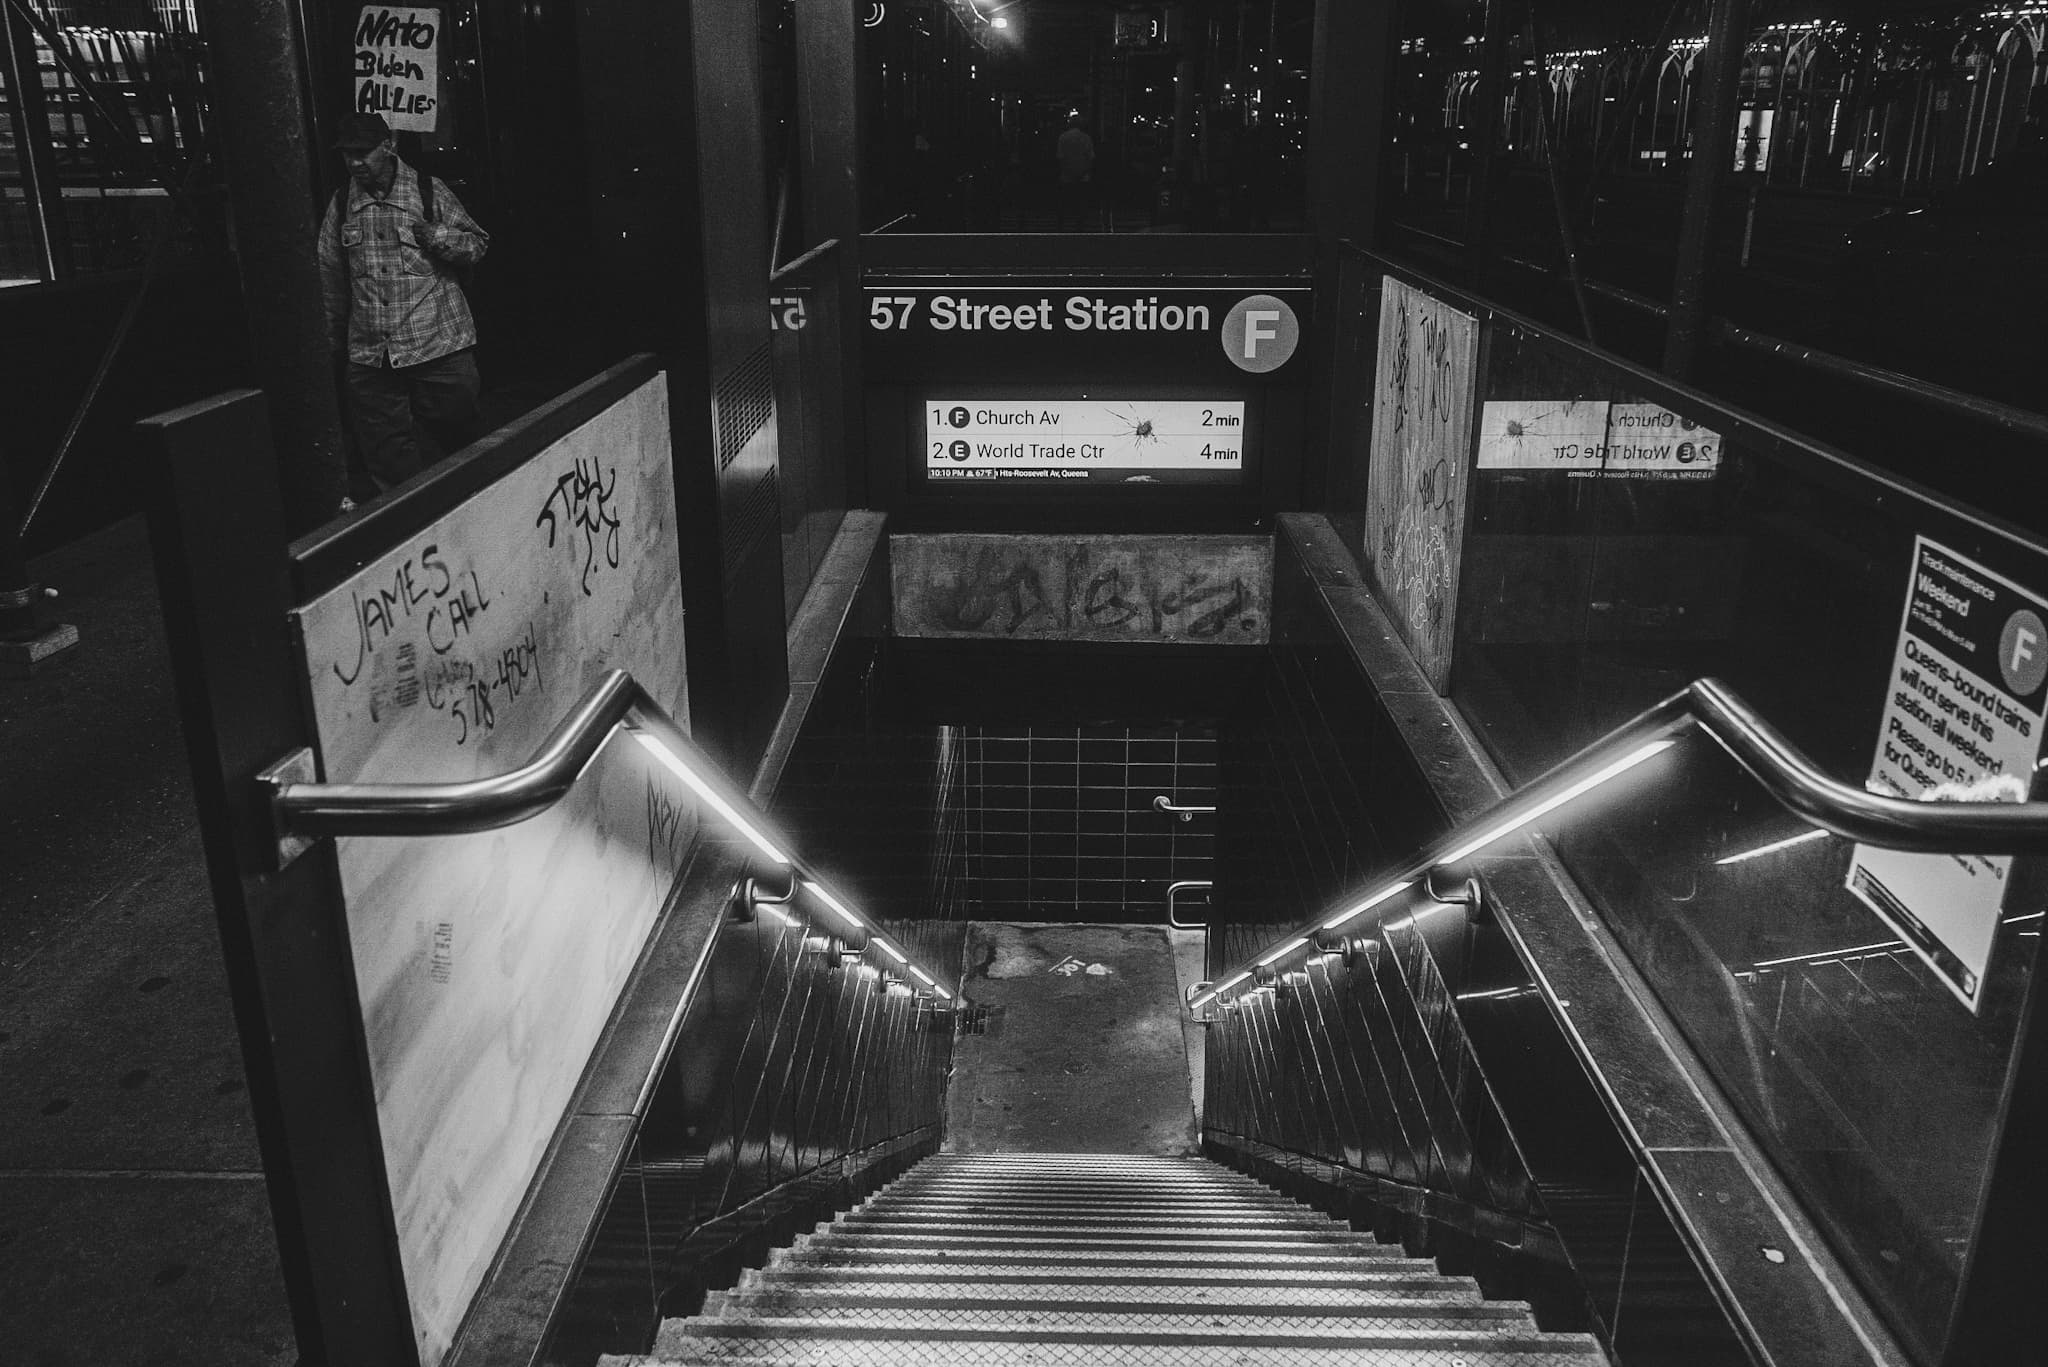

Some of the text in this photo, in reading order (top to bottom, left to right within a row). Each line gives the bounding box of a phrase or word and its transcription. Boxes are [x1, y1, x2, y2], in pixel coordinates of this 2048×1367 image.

[870, 295, 1210, 331] 57 Street Station
[1244, 310, 1280, 358] F
[932, 409, 948, 426] 1.
[976, 409, 1035, 425] Church
[1039, 410, 1060, 425] Av
[1201, 409, 1240, 427] 2 min
[932, 442, 948, 459] 2.
[976, 443, 1024, 459] World
[1029, 443, 1076, 459] Trade
[1080, 443, 1105, 459] Ctr
[1200, 443, 1238, 460] 4 min
[930, 469, 951, 477] 10:10
[952, 469, 965, 477] PM
[1061, 470, 1089, 478] Queens
[1918, 572, 1970, 617] Weekend
[1944, 564, 1996, 601] maintenance
[333, 544, 450, 686] JAMES
[426, 570, 490, 655] CALL
[2011, 627, 2037, 672] F
[1900, 667, 1995, 743] will not serve this
[1996, 698, 2032, 738] trains
[1884, 740, 1902, 765] for
[1888, 716, 1926, 758] Please
[1925, 748, 1942, 770] go
[1943, 756, 1955, 779] to
[1894, 691, 2004, 776] station all weekend
